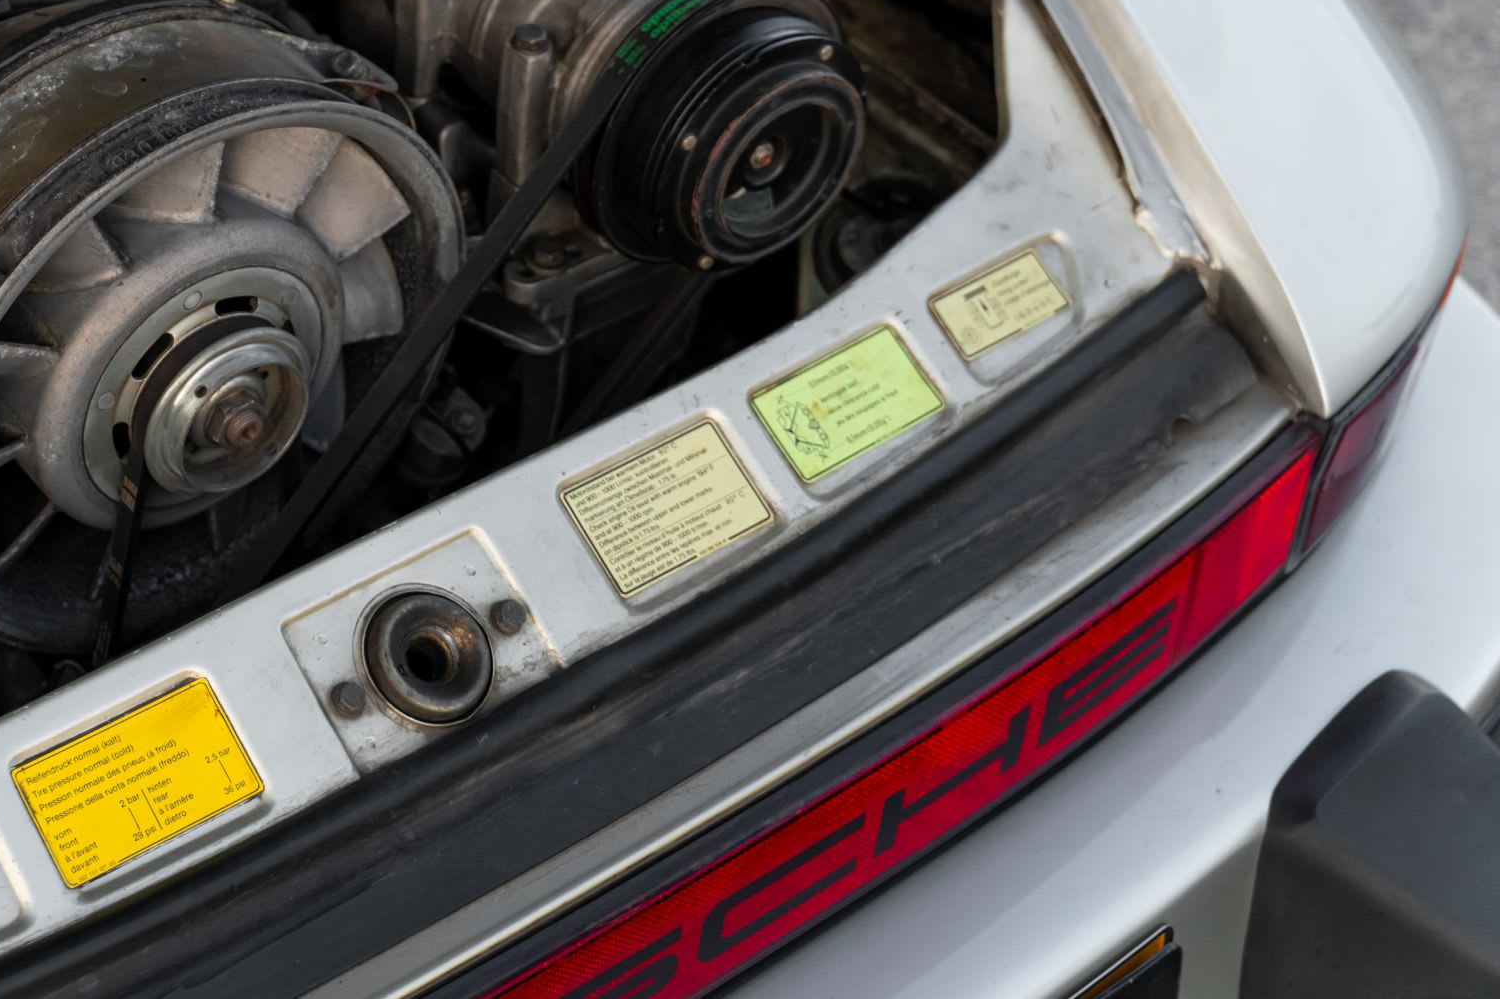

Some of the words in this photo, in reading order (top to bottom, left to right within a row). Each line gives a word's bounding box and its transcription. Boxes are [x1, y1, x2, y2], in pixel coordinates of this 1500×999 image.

[25, 758, 72, 786] Reifendruck
[72, 744, 101, 763] normal
[99, 733, 122, 750] (kalt)
[204, 752, 218, 763] 2.5
[217, 746, 231, 757] bar
[31, 786, 48, 799] Tire
[47, 769, 83, 792] pressure
[81, 754, 111, 774] normal
[109, 743, 135, 761] (cold)
[38, 790, 72, 812] Pression
[71, 773, 106, 795] normale
[104, 766, 121, 779] des
[120, 754, 146, 772] pneus
[154, 738, 177, 755] froid)
[44, 800, 84, 825] Pressione
[83, 790, 104, 806] della
[103, 779, 126, 796] ruota
[125, 763, 158, 785] normale
[157, 747, 190, 770] (freddo)
[146, 776, 172, 793] hinten
[222, 784, 235, 795] 36
[233, 778, 246, 790] psi
[152, 791, 169, 804] rear
[53, 827, 72, 841] vorn
[118, 799, 126, 807] 2
[125, 792, 140, 804] bar
[157, 806, 165, 815] à
[163, 809, 187, 825] dietro
[132, 831, 144, 842] 29
[143, 824, 158, 836] psi
[58, 837, 79, 852] front
[63, 854, 71, 863] à
[70, 841, 98, 859] l'avant
[69, 853, 100, 874] davanti
